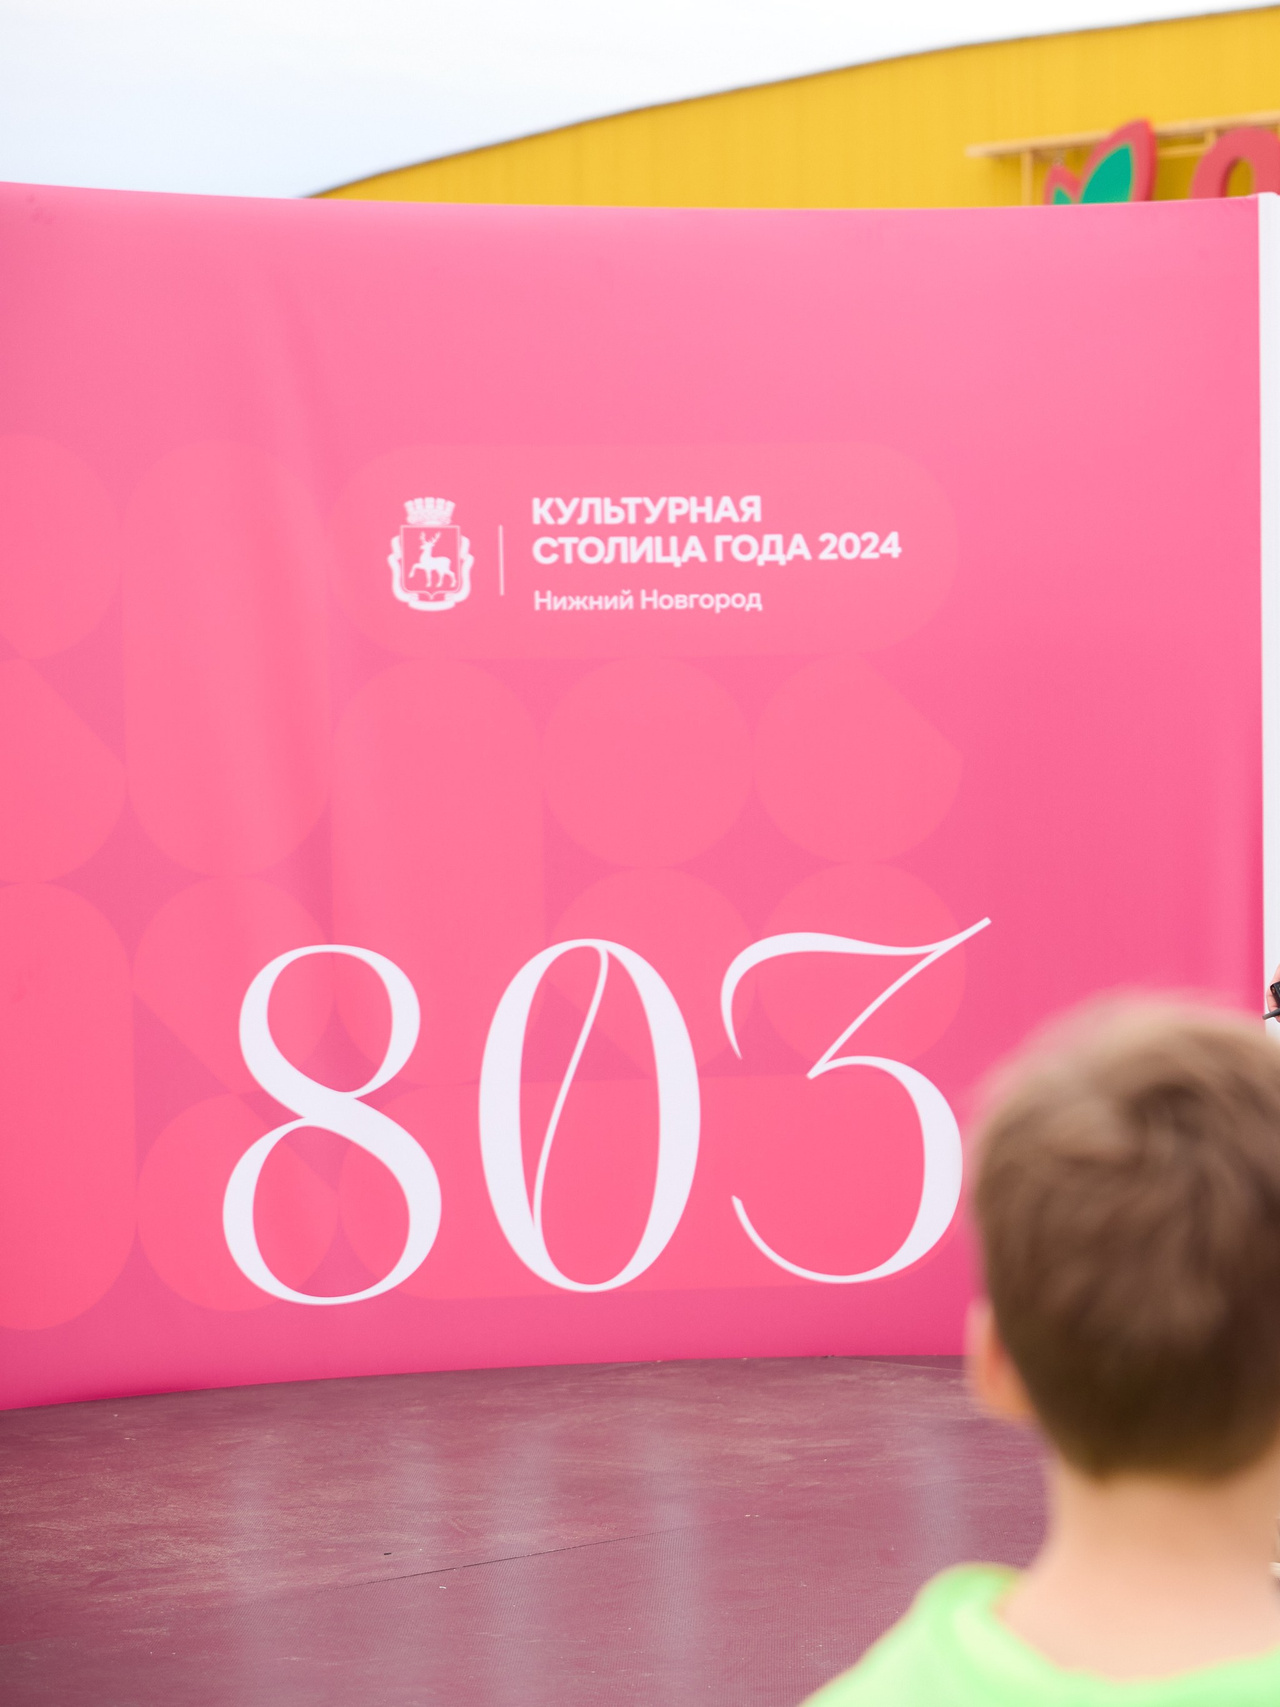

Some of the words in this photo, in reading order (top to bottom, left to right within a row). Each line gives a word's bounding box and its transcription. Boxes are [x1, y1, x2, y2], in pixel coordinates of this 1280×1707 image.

[532, 495, 762, 525] КУЛЬТУРНАЯ
[532, 535, 708, 568] СТОЛИЦА
[714, 533, 812, 567] ГОДА
[818, 531, 902, 560] 2024
[534, 589, 634, 611] Нижний
[640, 589, 763, 614] Новгород
[222, 917, 991, 1305] 803
